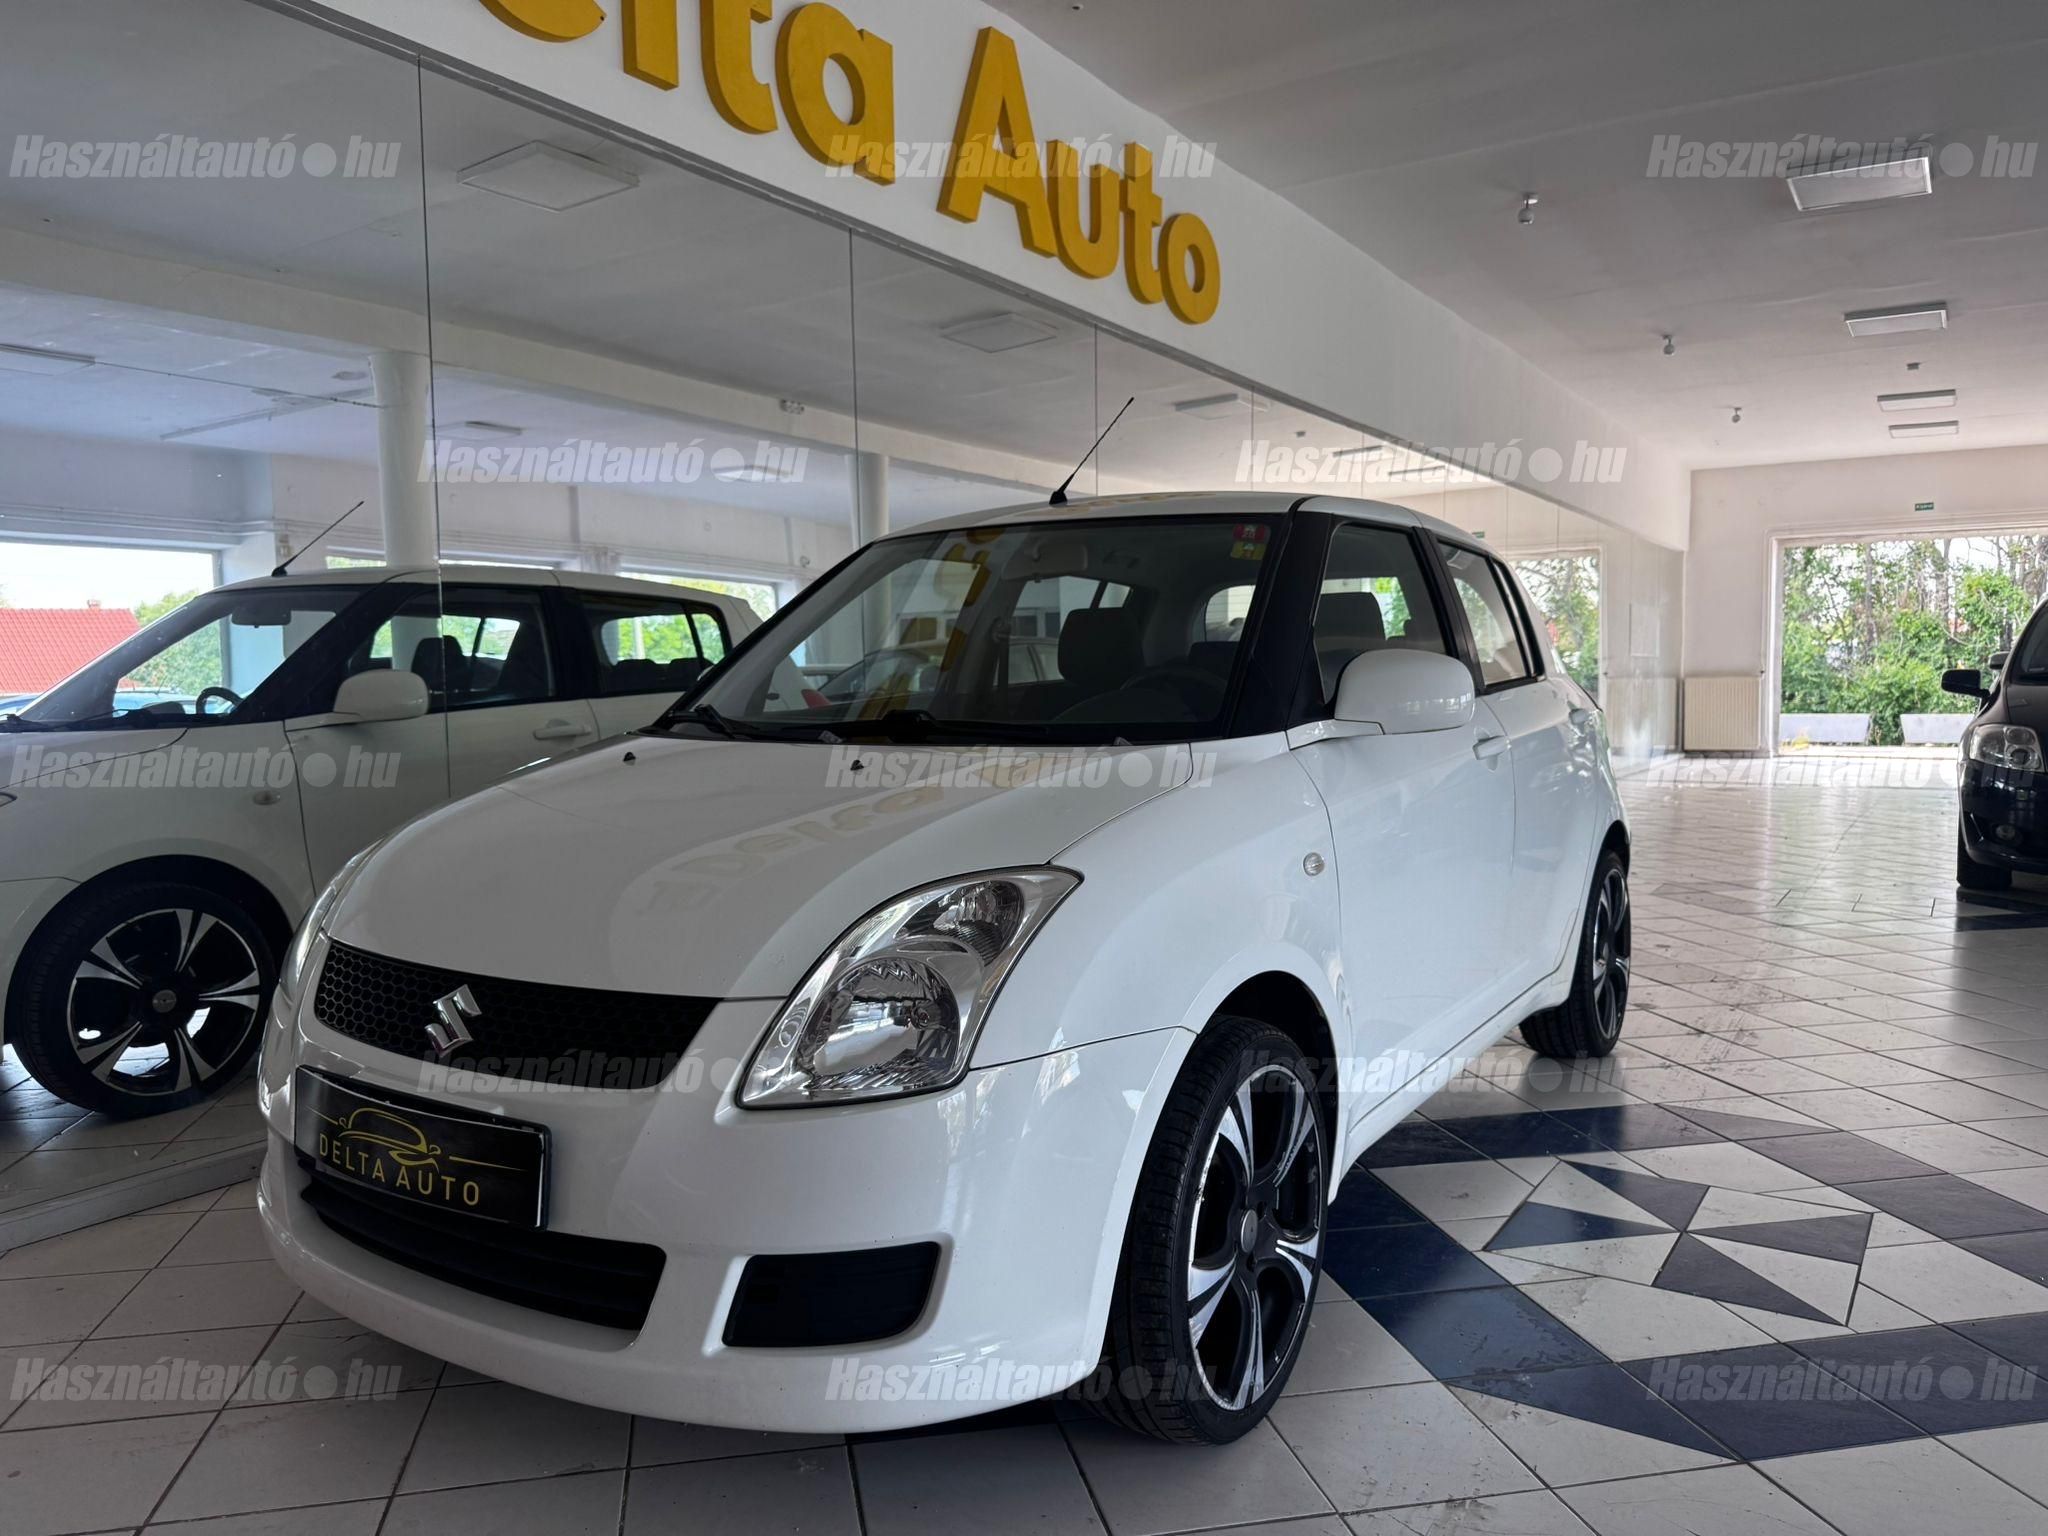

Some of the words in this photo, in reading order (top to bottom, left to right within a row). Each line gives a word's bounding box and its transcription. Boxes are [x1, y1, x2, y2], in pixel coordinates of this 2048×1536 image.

[936, 26, 1221, 325] Auto
[319, 1133, 386, 1183] DELTA
[396, 1165, 480, 1206] AUTO
